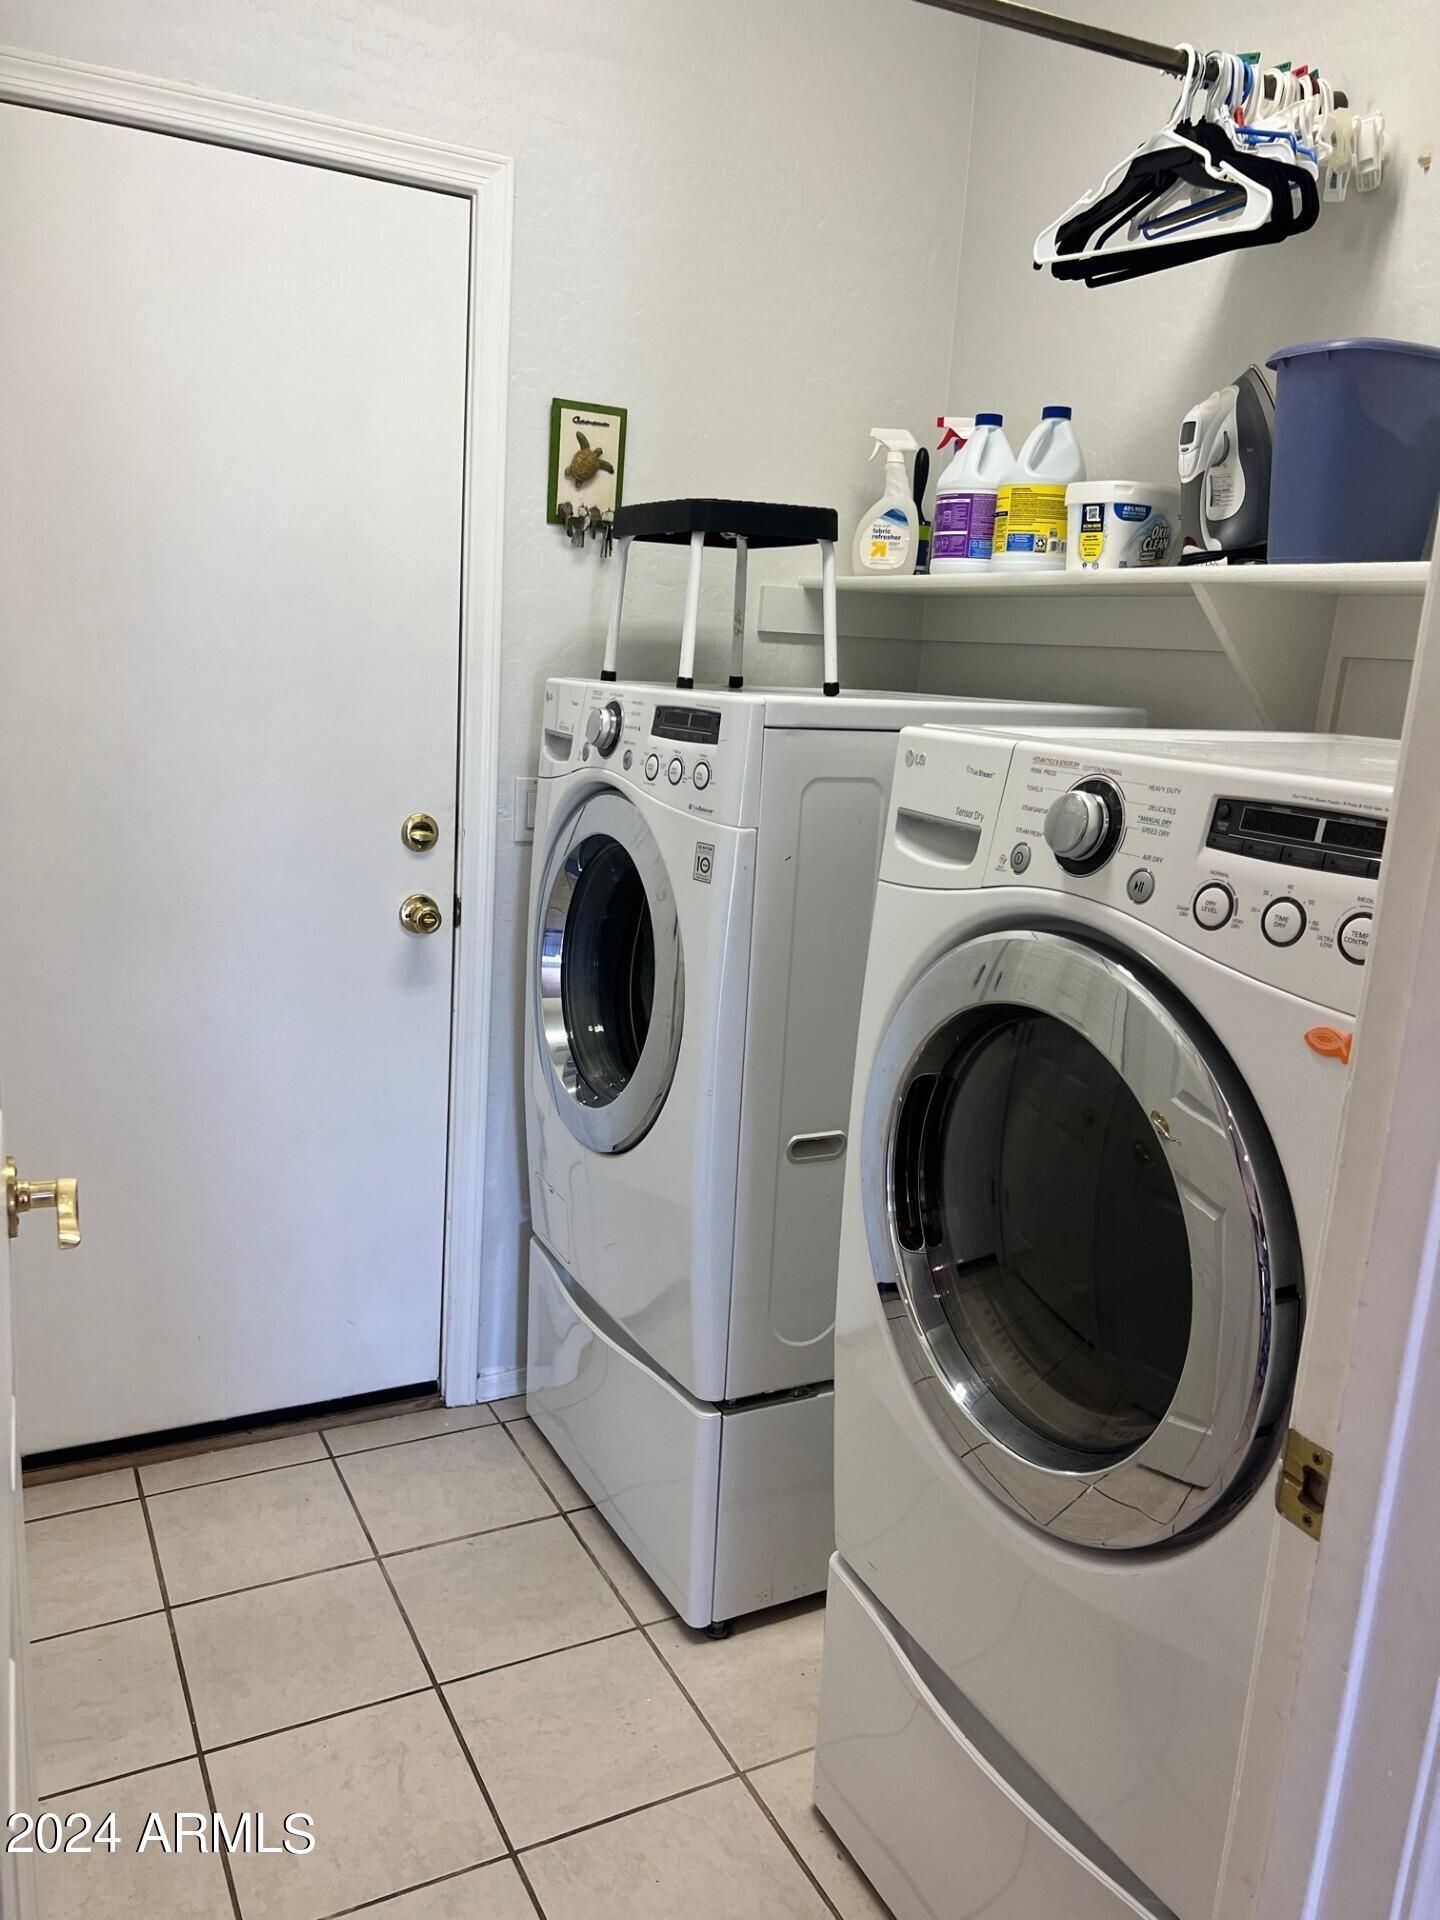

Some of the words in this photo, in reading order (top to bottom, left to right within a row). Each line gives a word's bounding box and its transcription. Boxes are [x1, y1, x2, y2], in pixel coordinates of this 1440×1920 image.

[1142, 537, 1168, 551] CLEAN
[1148, 785, 1165, 793] HEAVY
[1166, 787, 1181, 795] DUTY
[955, 806, 974, 818] Sensor
[974, 811, 985, 822] Dry
[1148, 805, 1176, 815] DELICATES
[1141, 827, 1158, 836] SPEED
[1201, 905, 1218, 914] LEVEL
[1274, 914, 1289, 922] TIME
[1344, 936, 1369, 947] CONTR
